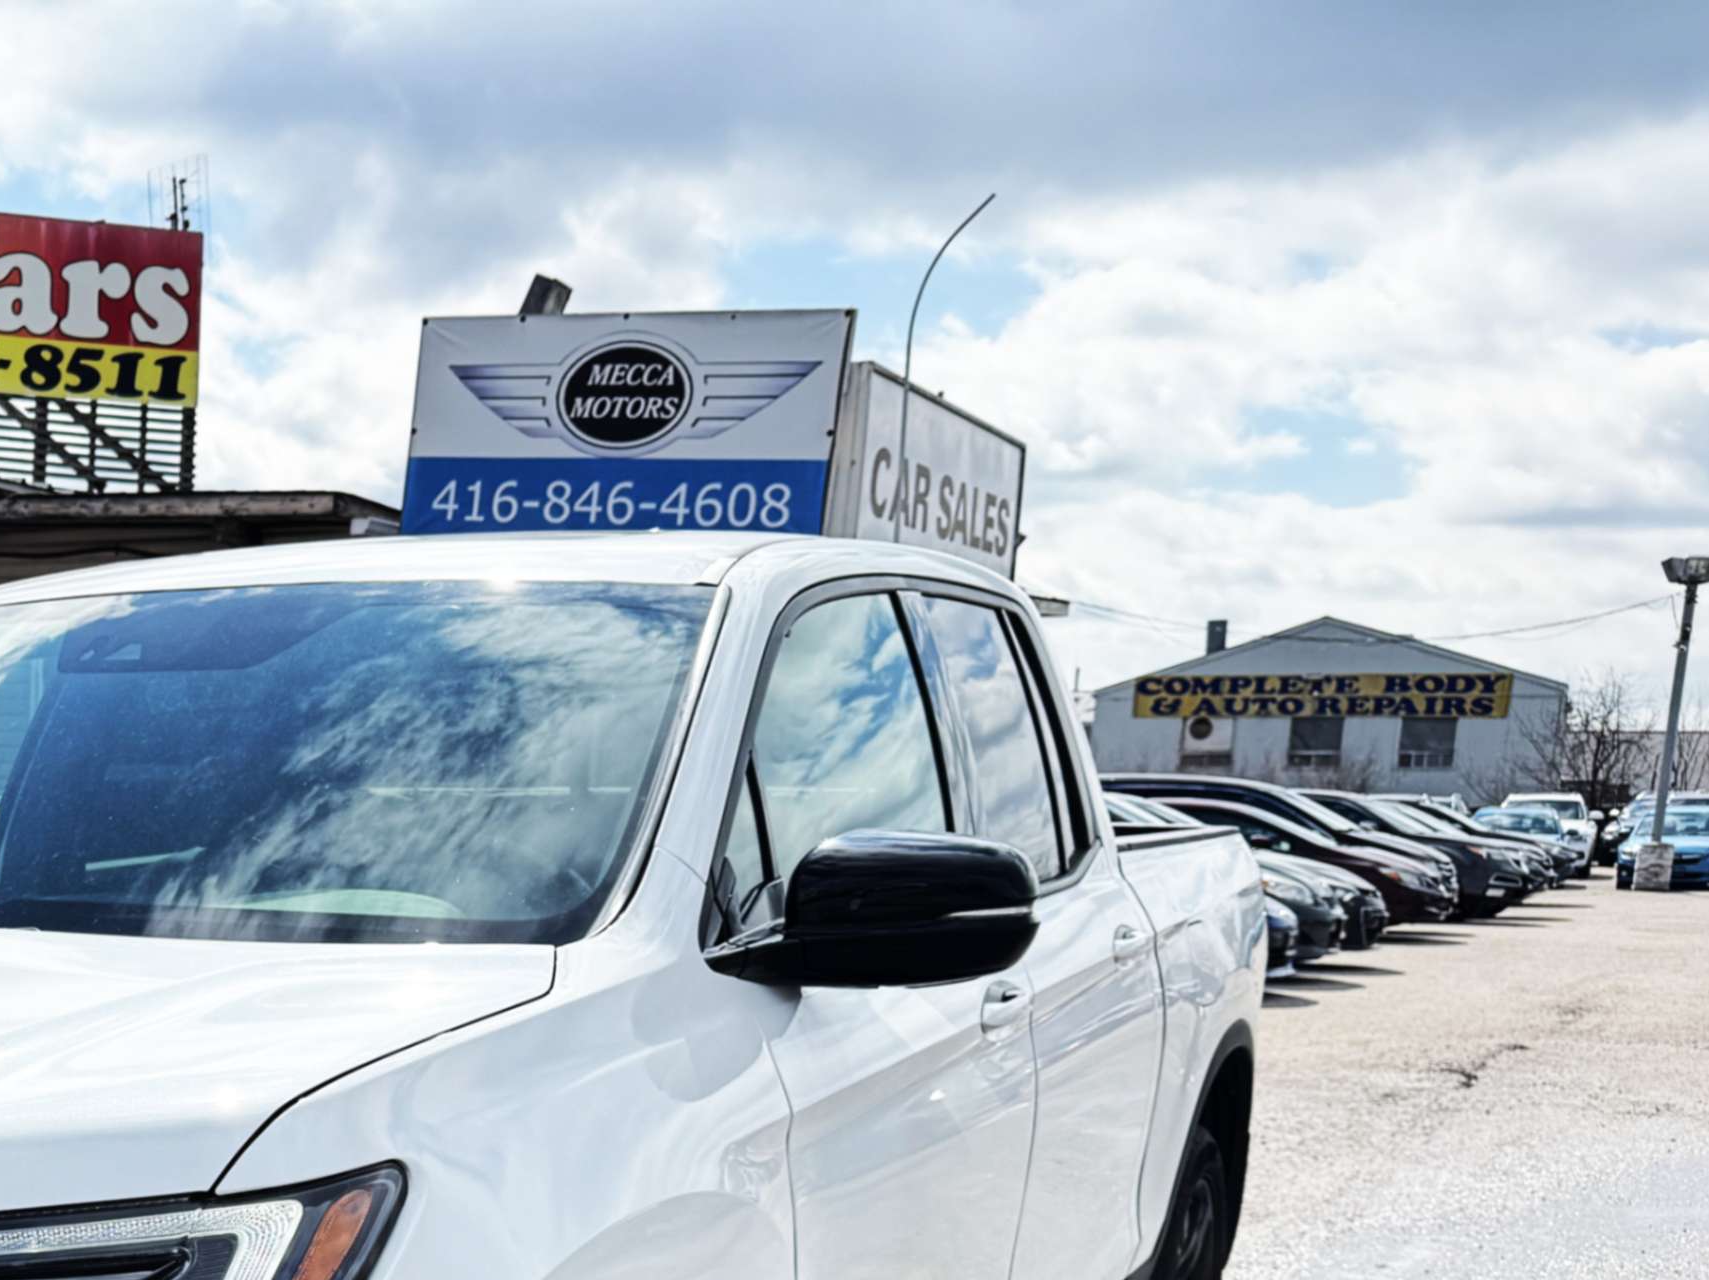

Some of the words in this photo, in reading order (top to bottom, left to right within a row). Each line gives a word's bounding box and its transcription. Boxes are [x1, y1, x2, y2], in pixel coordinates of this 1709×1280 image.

[587, 363, 675, 386] MECCA
[570, 396, 680, 419] MOTORS
[432, 480, 793, 529] 416-846-4608
[870, 447, 931, 533] CAR
[936, 474, 1010, 557] SALES
[1136, 674, 1360, 696] COMPLETE
[1383, 674, 1508, 694] BODY
[1150, 697, 1182, 717] &
[1193, 697, 1305, 717] AUTO
[1312, 696, 1496, 717] REPAIRS
